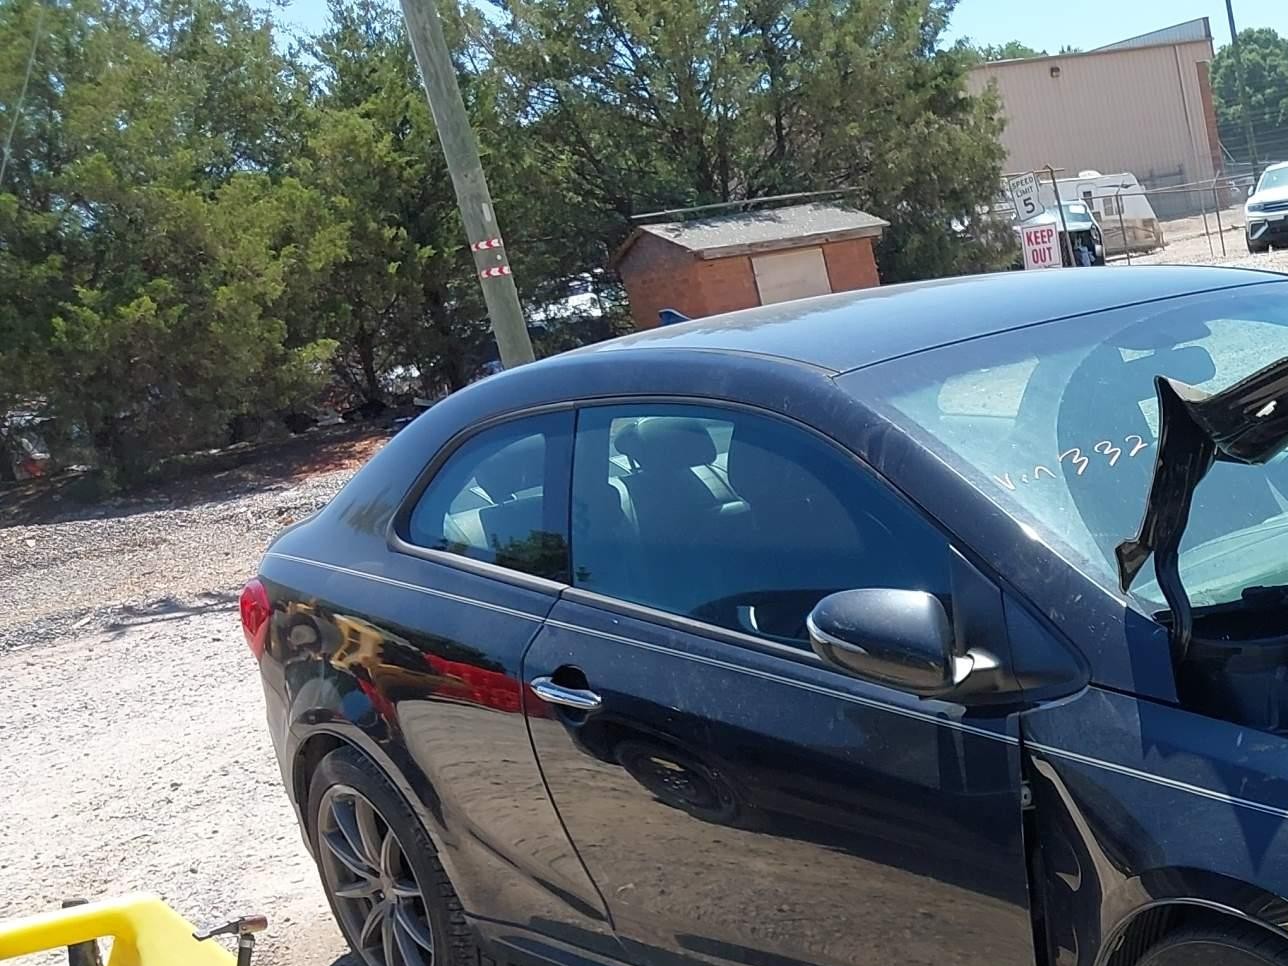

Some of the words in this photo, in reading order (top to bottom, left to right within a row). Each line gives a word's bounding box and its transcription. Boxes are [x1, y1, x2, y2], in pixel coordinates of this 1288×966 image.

[1012, 177, 1033, 189] SPEED
[1016, 186, 1033, 198] LIMIT
[1023, 197, 1035, 213] 5
[1026, 229, 1053, 246] KEEP
[1031, 247, 1053, 264] OUT
[1059, 435, 1149, 475] 332
